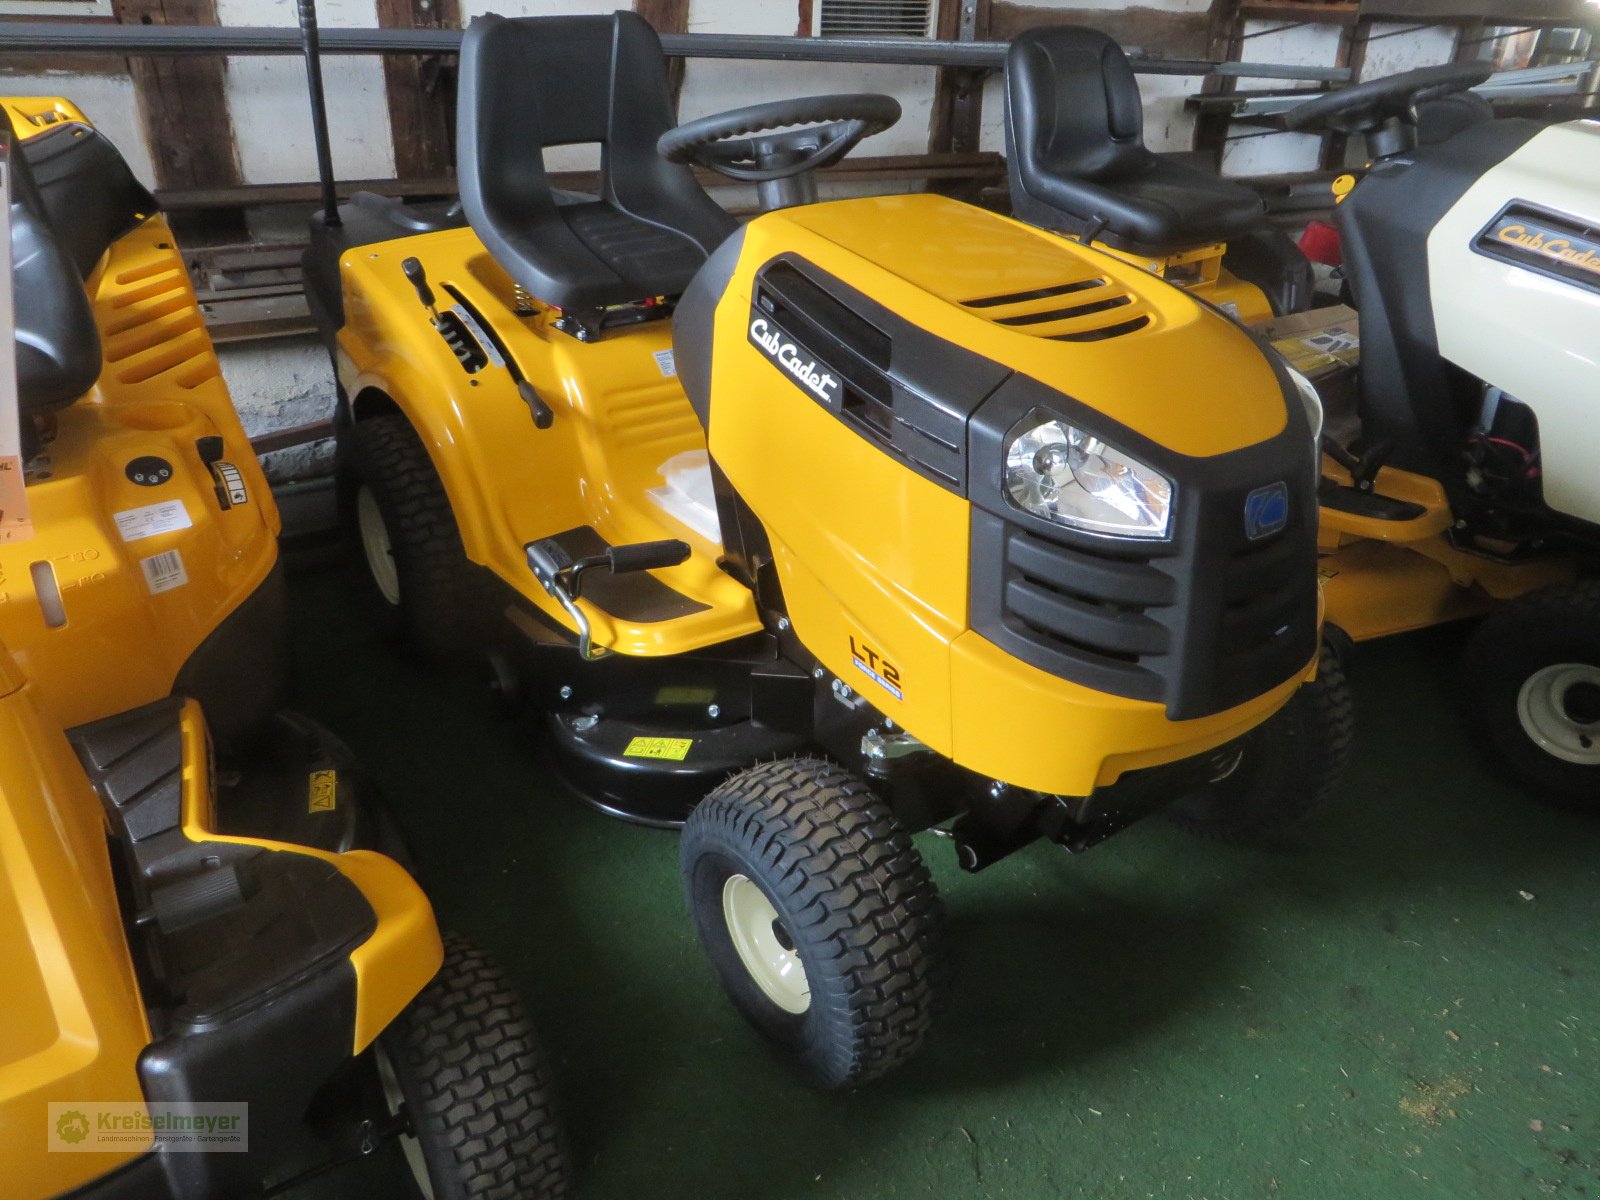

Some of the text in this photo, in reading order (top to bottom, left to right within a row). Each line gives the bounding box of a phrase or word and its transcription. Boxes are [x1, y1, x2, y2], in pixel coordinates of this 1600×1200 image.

[1498, 225, 1545, 250] Cub
[750, 319, 838, 401] Cub Cadet
[853, 656, 878, 681] FORCE
